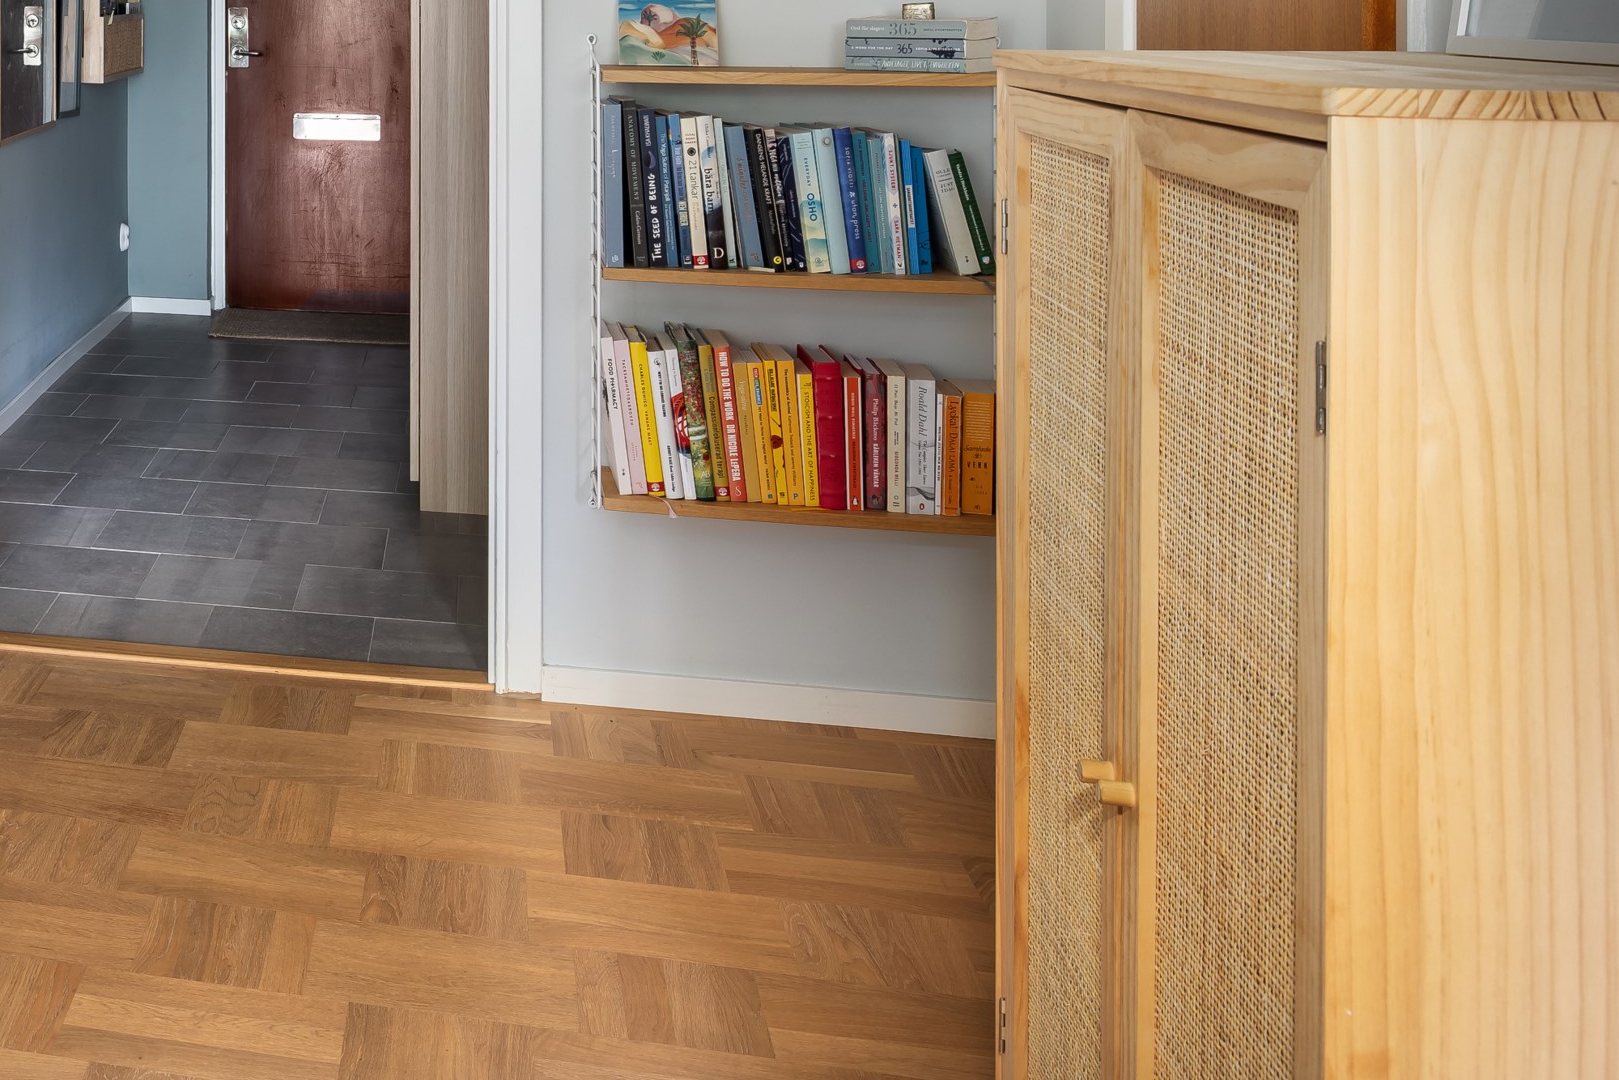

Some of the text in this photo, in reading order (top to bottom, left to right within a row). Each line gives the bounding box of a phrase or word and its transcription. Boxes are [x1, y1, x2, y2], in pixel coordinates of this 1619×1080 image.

[889, 22, 917, 36] 365
[897, 43, 913, 54] 365
[627, 114, 639, 201] ANATOMY OF MOVEMENT
[660, 143, 668, 156] Yoga
[755, 133, 765, 161] DANSENS
[760, 162, 769, 187] HELANDE
[689, 160, 700, 199] 21 tankar
[803, 157, 818, 221] EVERYDAY OSHO
[704, 168, 715, 213] bära barn
[647, 173, 662, 261] THE SEED OF BEING
[850, 219, 860, 240] press
[607, 358, 615, 376] FOOD
[719, 352, 727, 366] HOW
[721, 378, 730, 387] DO
[722, 388, 732, 400] THE
[724, 401, 734, 420] WORK
[871, 398, 879, 415] Philip
[918, 386, 927, 436] Roald Dahl
[948, 401, 958, 429] Lycka!
[709, 396, 723, 460] Compassionfokuserad
[717, 461, 725, 478] terapi
[726, 424, 735, 433] DR
[728, 434, 738, 456] NICOLE
